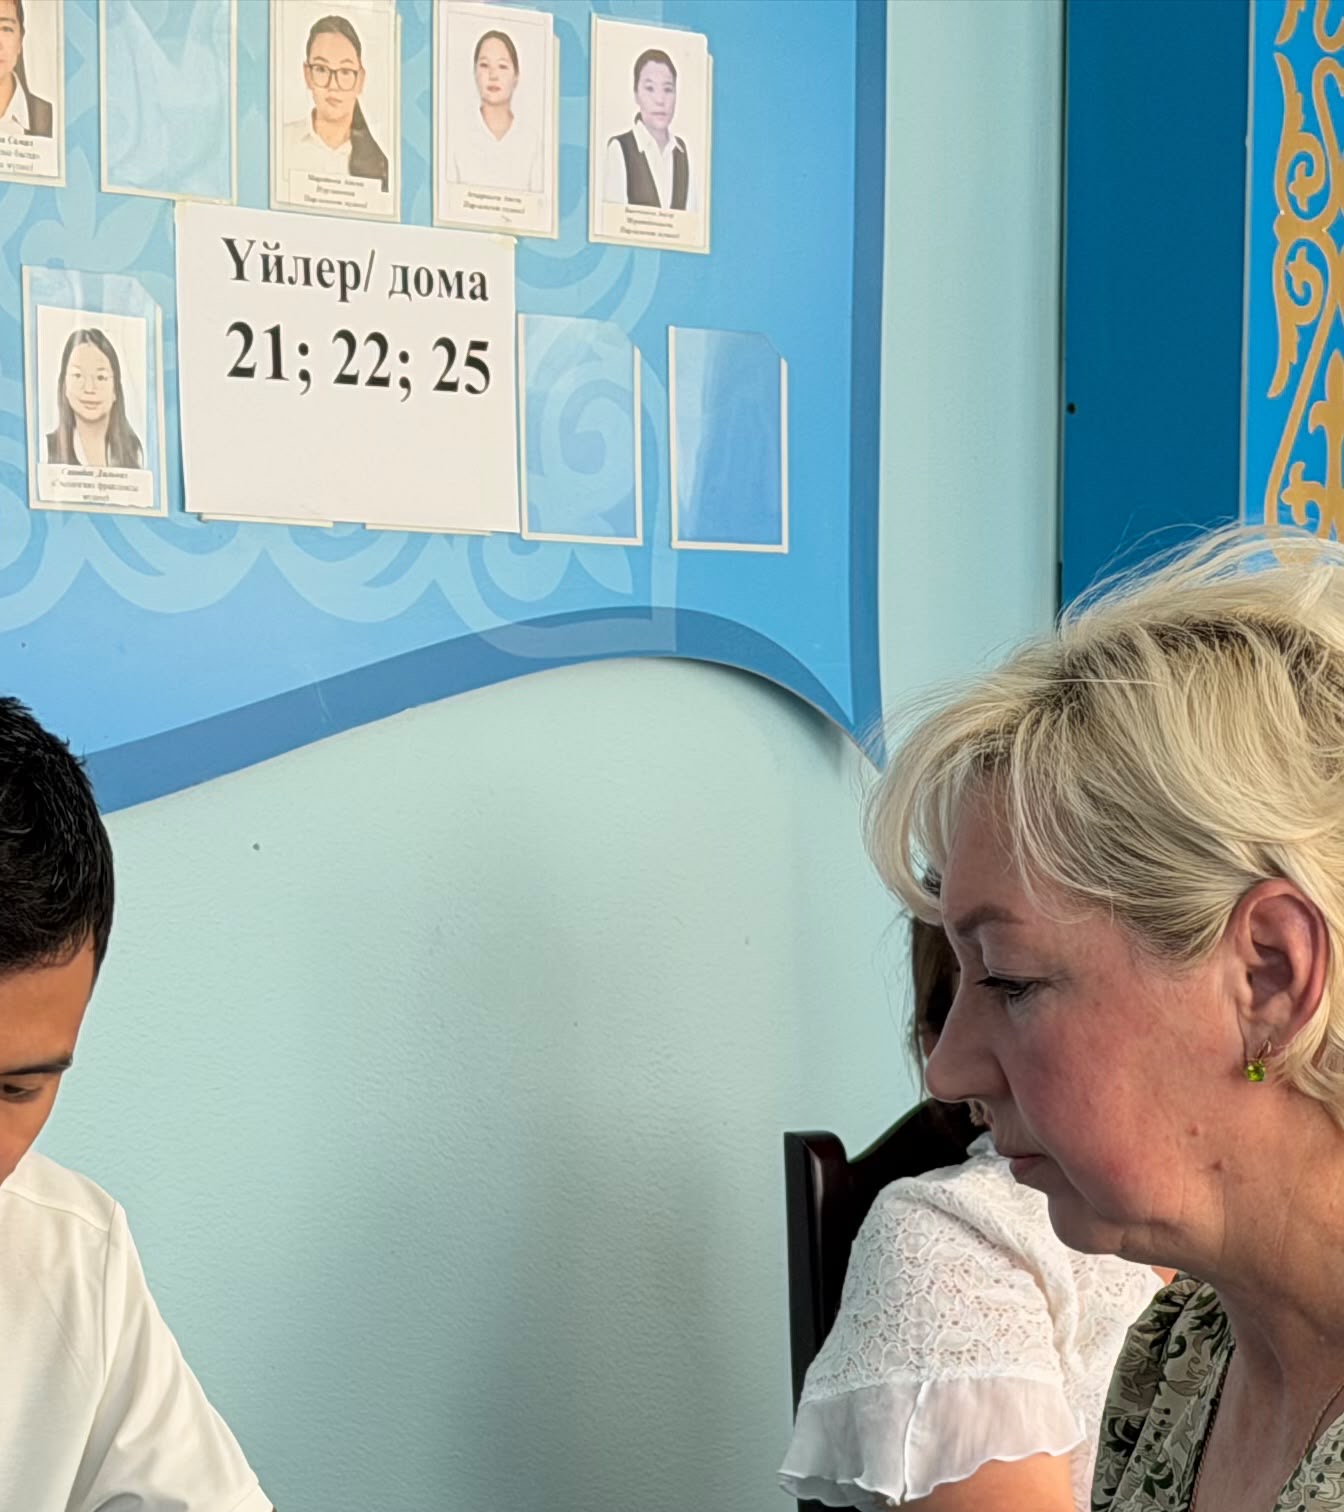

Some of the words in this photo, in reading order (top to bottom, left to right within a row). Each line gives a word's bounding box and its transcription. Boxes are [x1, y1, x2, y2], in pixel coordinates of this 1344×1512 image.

[388, 264, 489, 302] дома
[225, 321, 311, 395] 21;
[332, 329, 411, 402] 22;
[431, 336, 490, 394] 25
